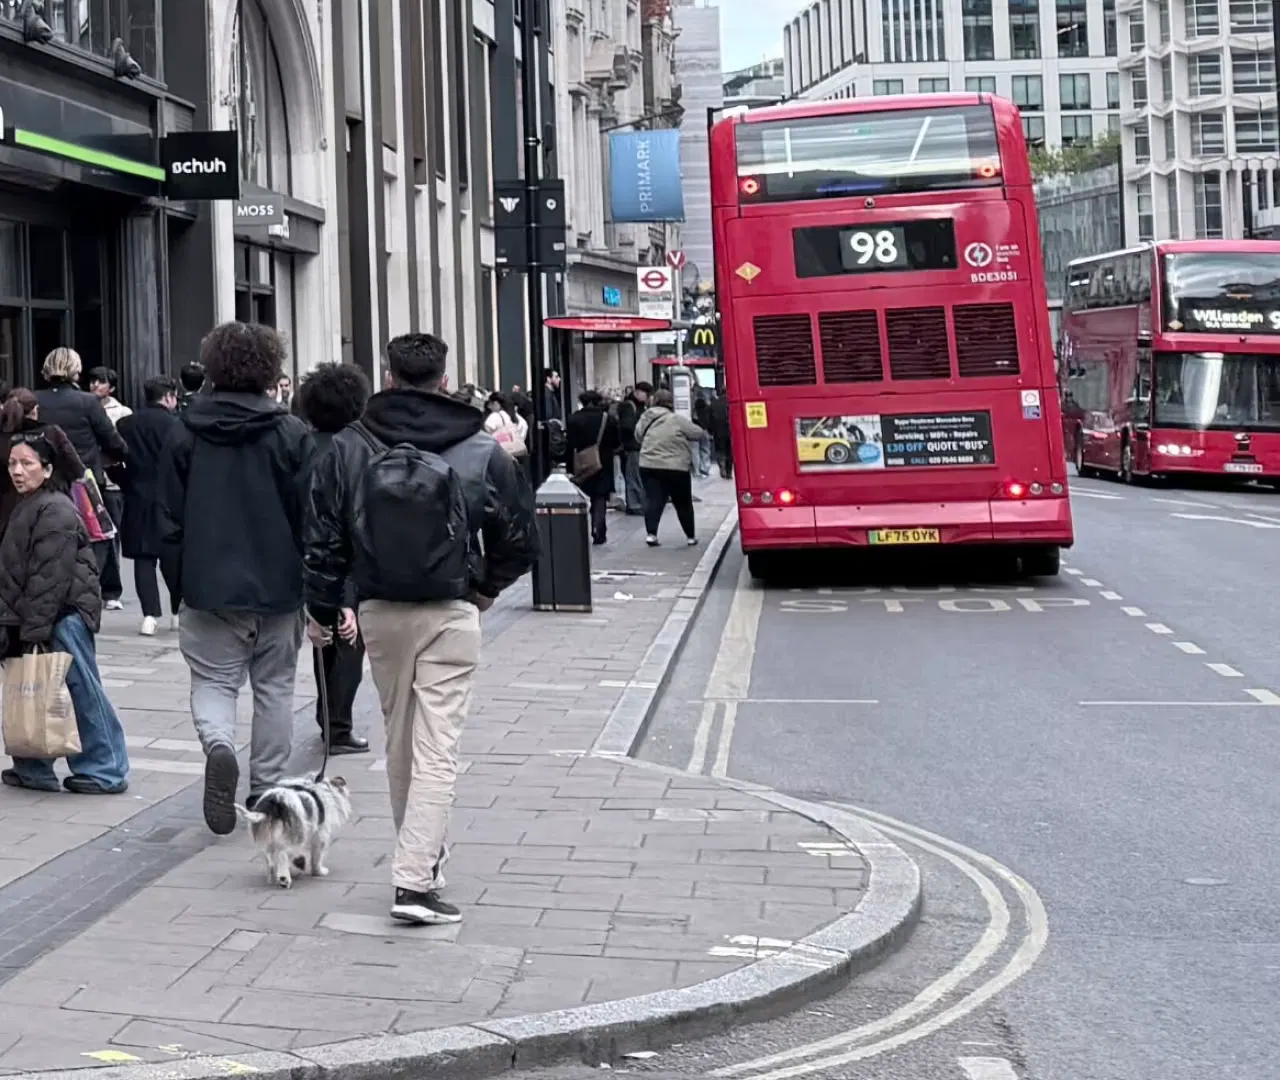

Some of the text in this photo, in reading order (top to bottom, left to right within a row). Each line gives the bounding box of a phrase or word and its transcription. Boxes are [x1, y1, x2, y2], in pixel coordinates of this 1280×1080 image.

[171, 157, 227, 174] schuh
[636, 139, 655, 213] PRIMARK
[237, 205, 274, 217] MOSS
[850, 230, 897, 264] 98
[927, 441, 958, 452] QUOTE
[878, 530, 910, 542] LF75
[779, 598, 1090, 613] STOP
